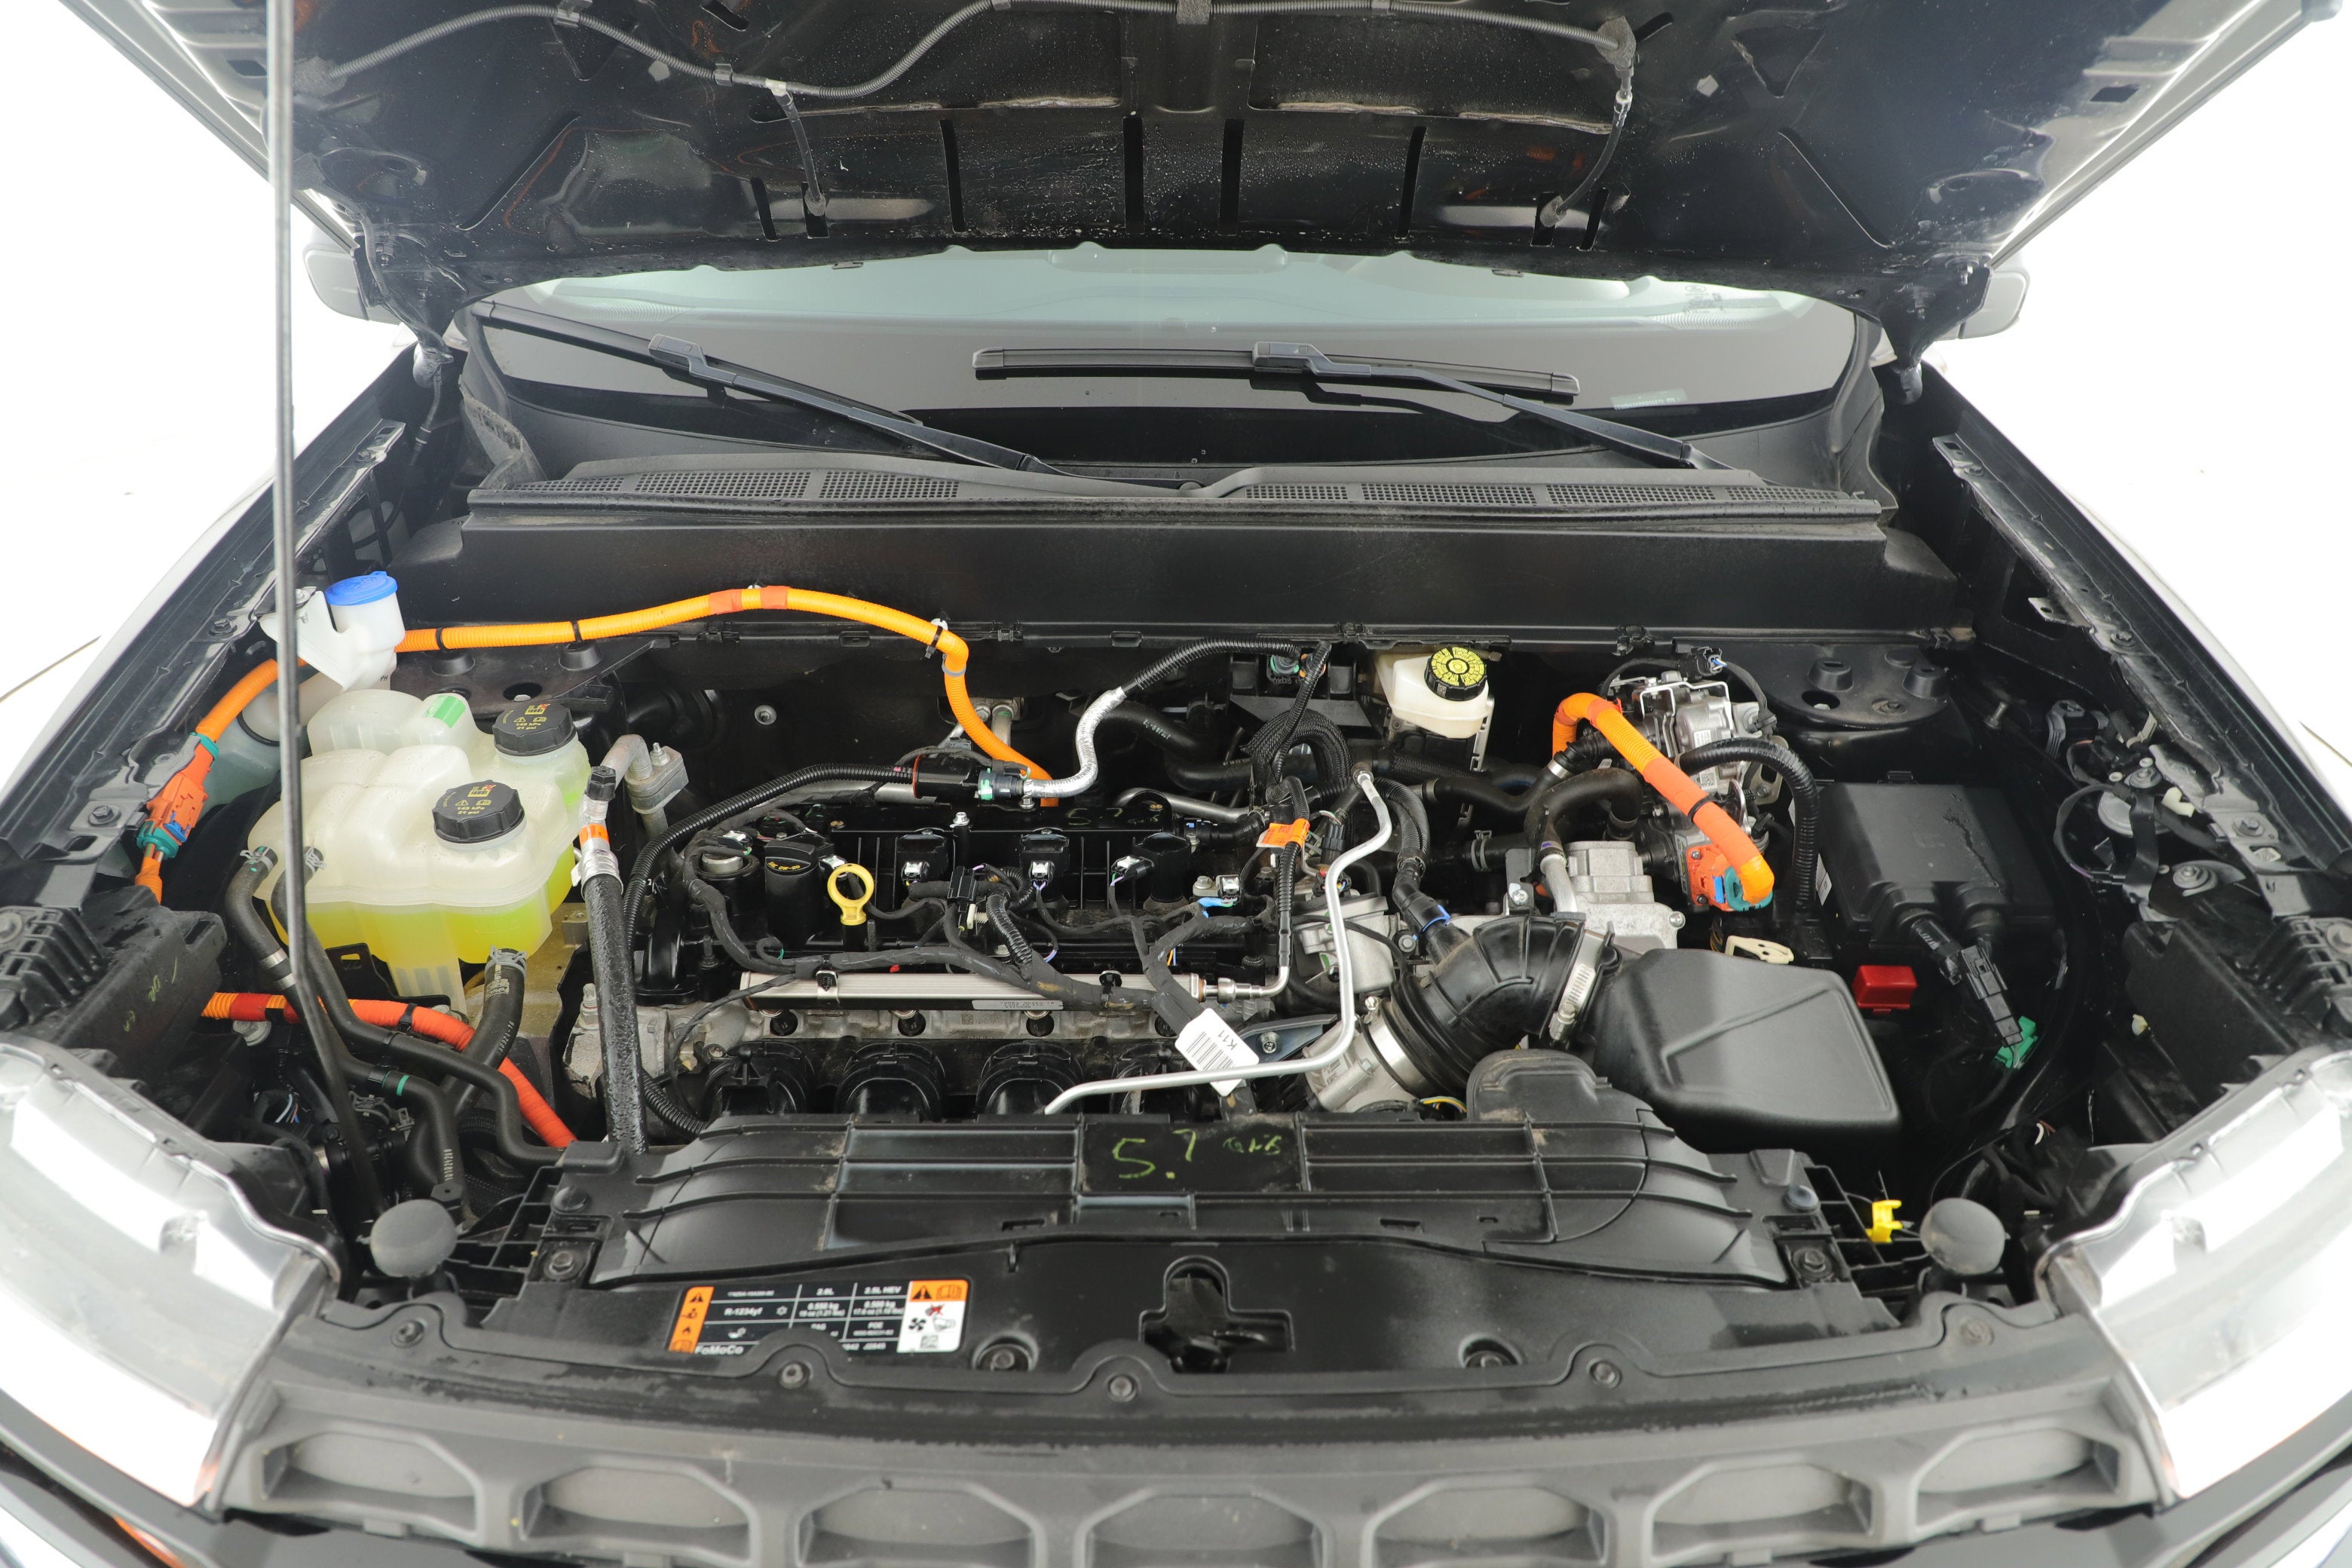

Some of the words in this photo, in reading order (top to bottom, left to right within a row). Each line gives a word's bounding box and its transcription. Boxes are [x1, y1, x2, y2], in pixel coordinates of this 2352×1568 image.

[1217, 1030, 1238, 1050] K11
[882, 1285, 902, 1294] HEV
[724, 1306, 764, 1316] R-1234yf
[694, 1344, 744, 1355] FoMoCo
